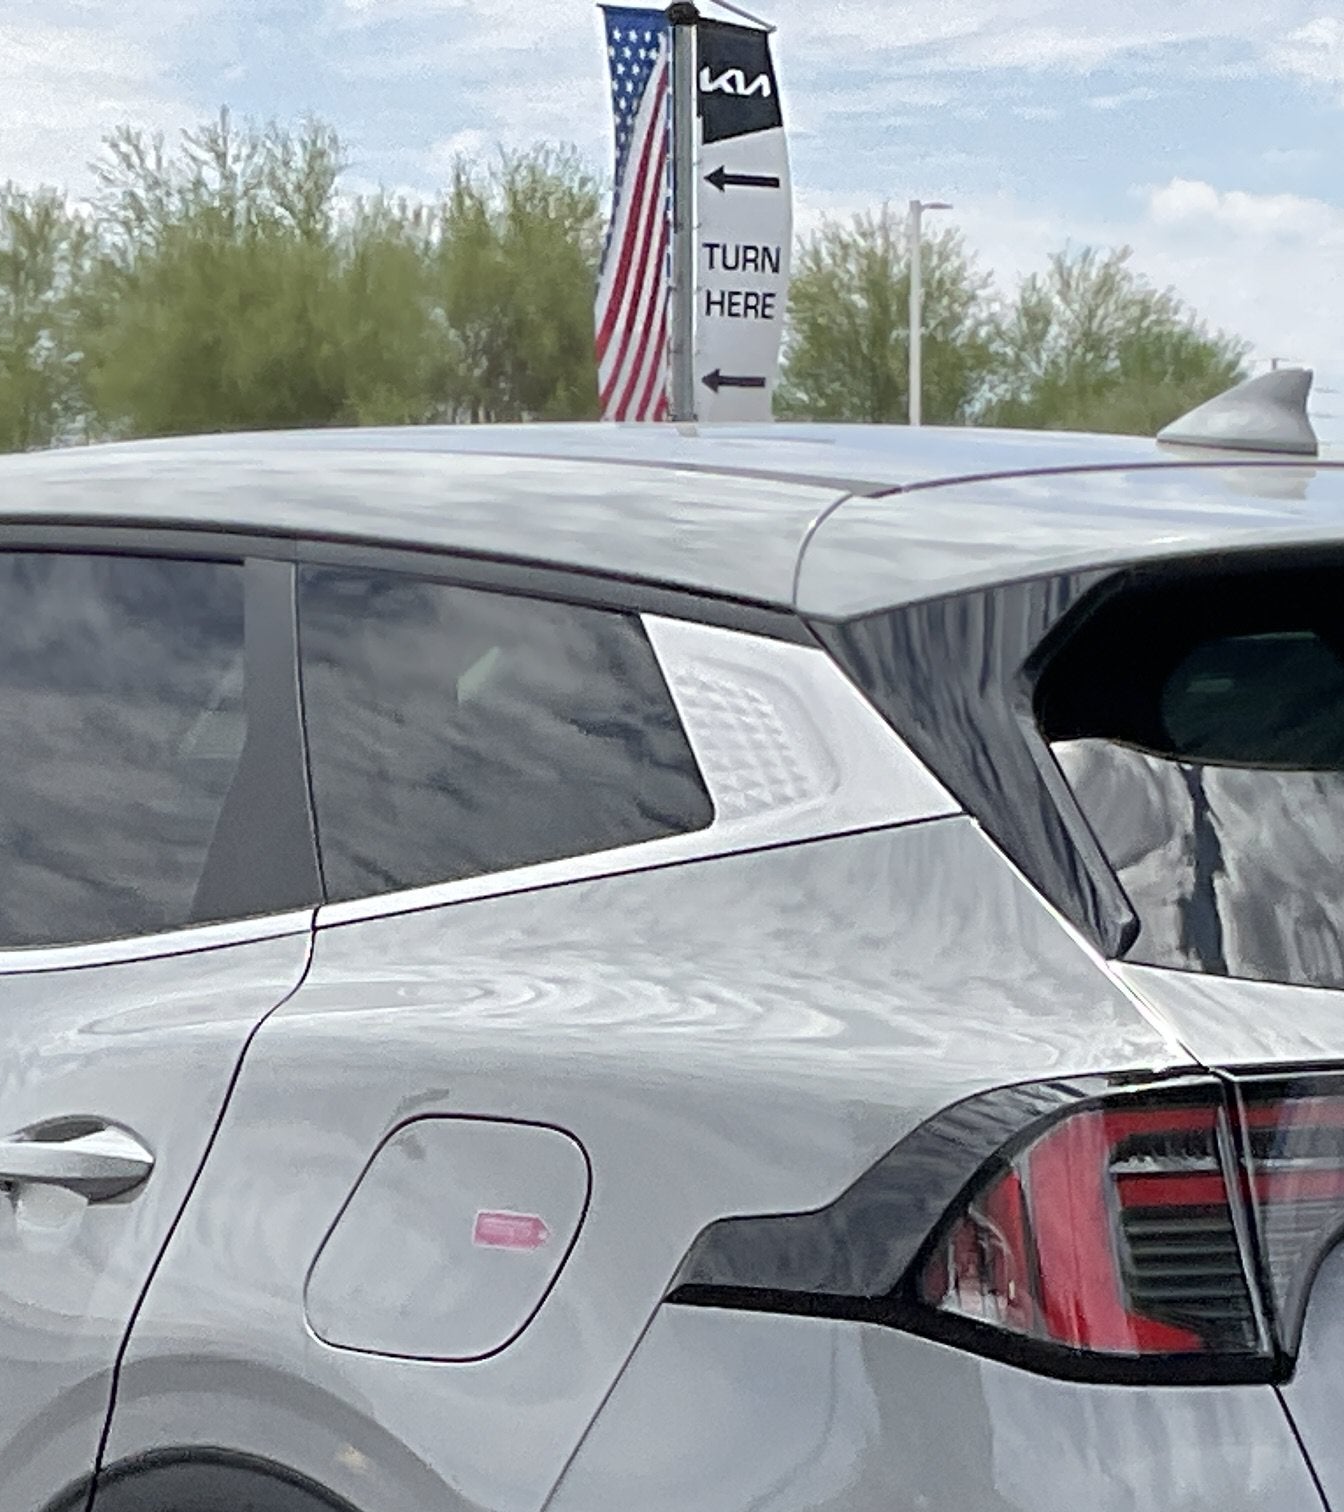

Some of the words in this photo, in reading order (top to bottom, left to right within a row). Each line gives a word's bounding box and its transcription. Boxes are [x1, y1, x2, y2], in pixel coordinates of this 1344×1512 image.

[699, 66, 770, 97] KIA
[702, 243, 780, 273] TURN
[705, 289, 776, 319] HERE
